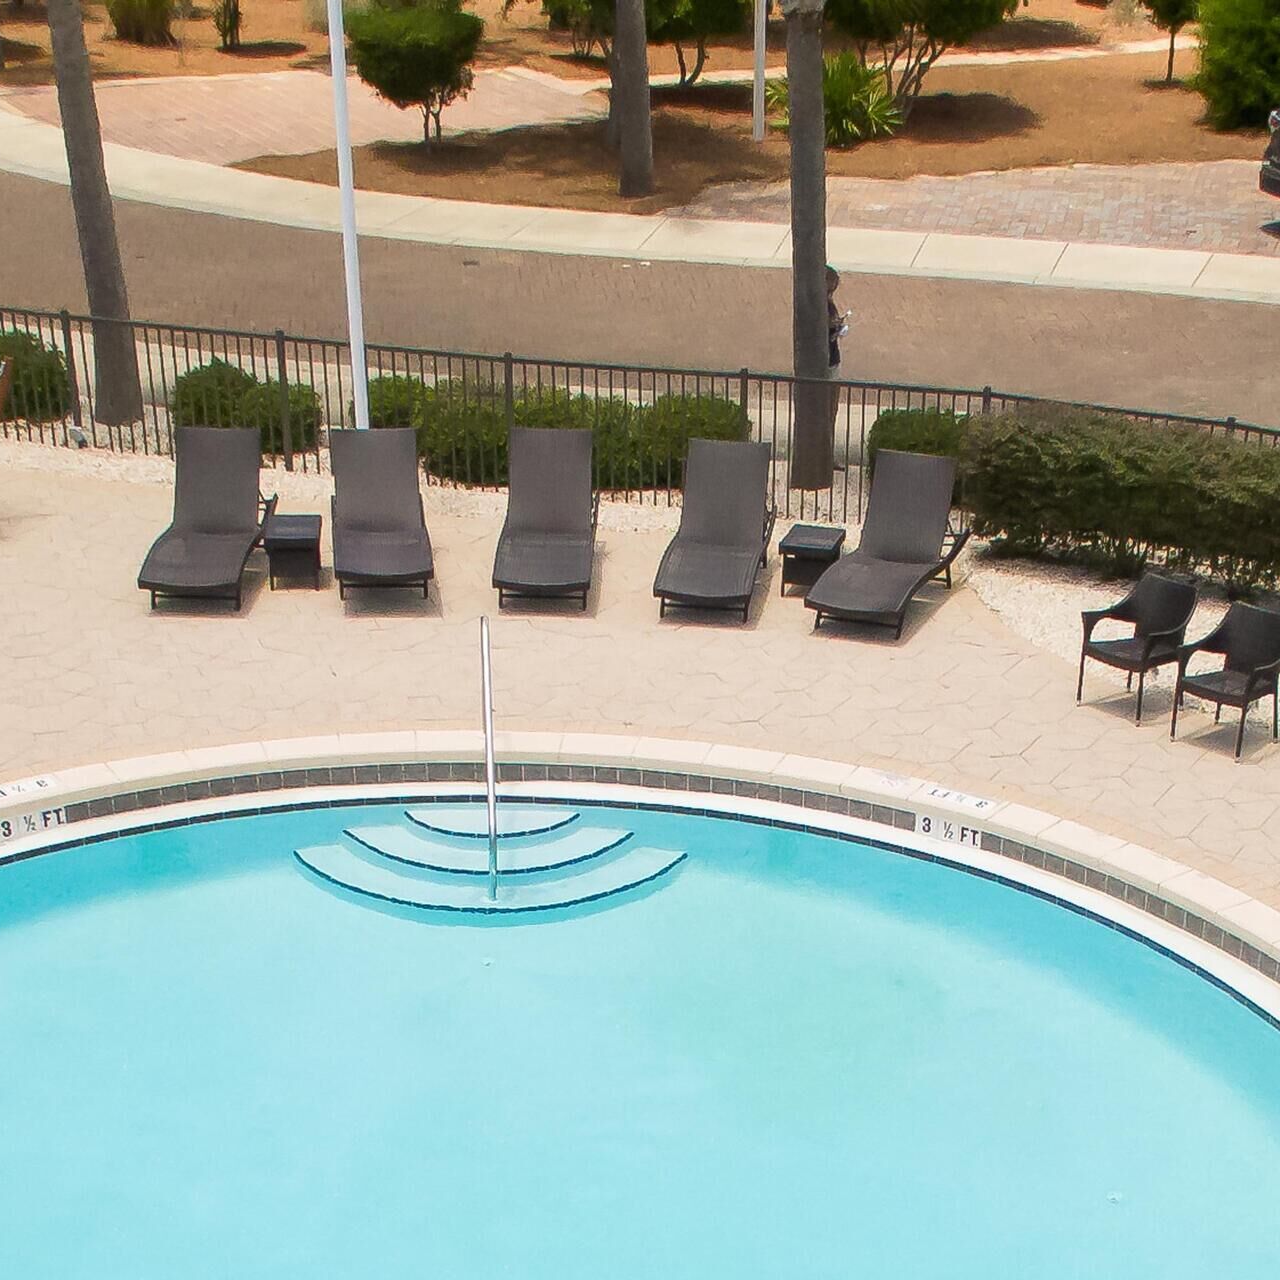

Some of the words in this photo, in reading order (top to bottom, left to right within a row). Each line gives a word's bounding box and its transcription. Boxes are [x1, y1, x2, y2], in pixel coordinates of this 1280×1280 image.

[0, 820, 13, 838] 3
[921, 817, 932, 833] 3
[959, 826, 980, 847] FT.
